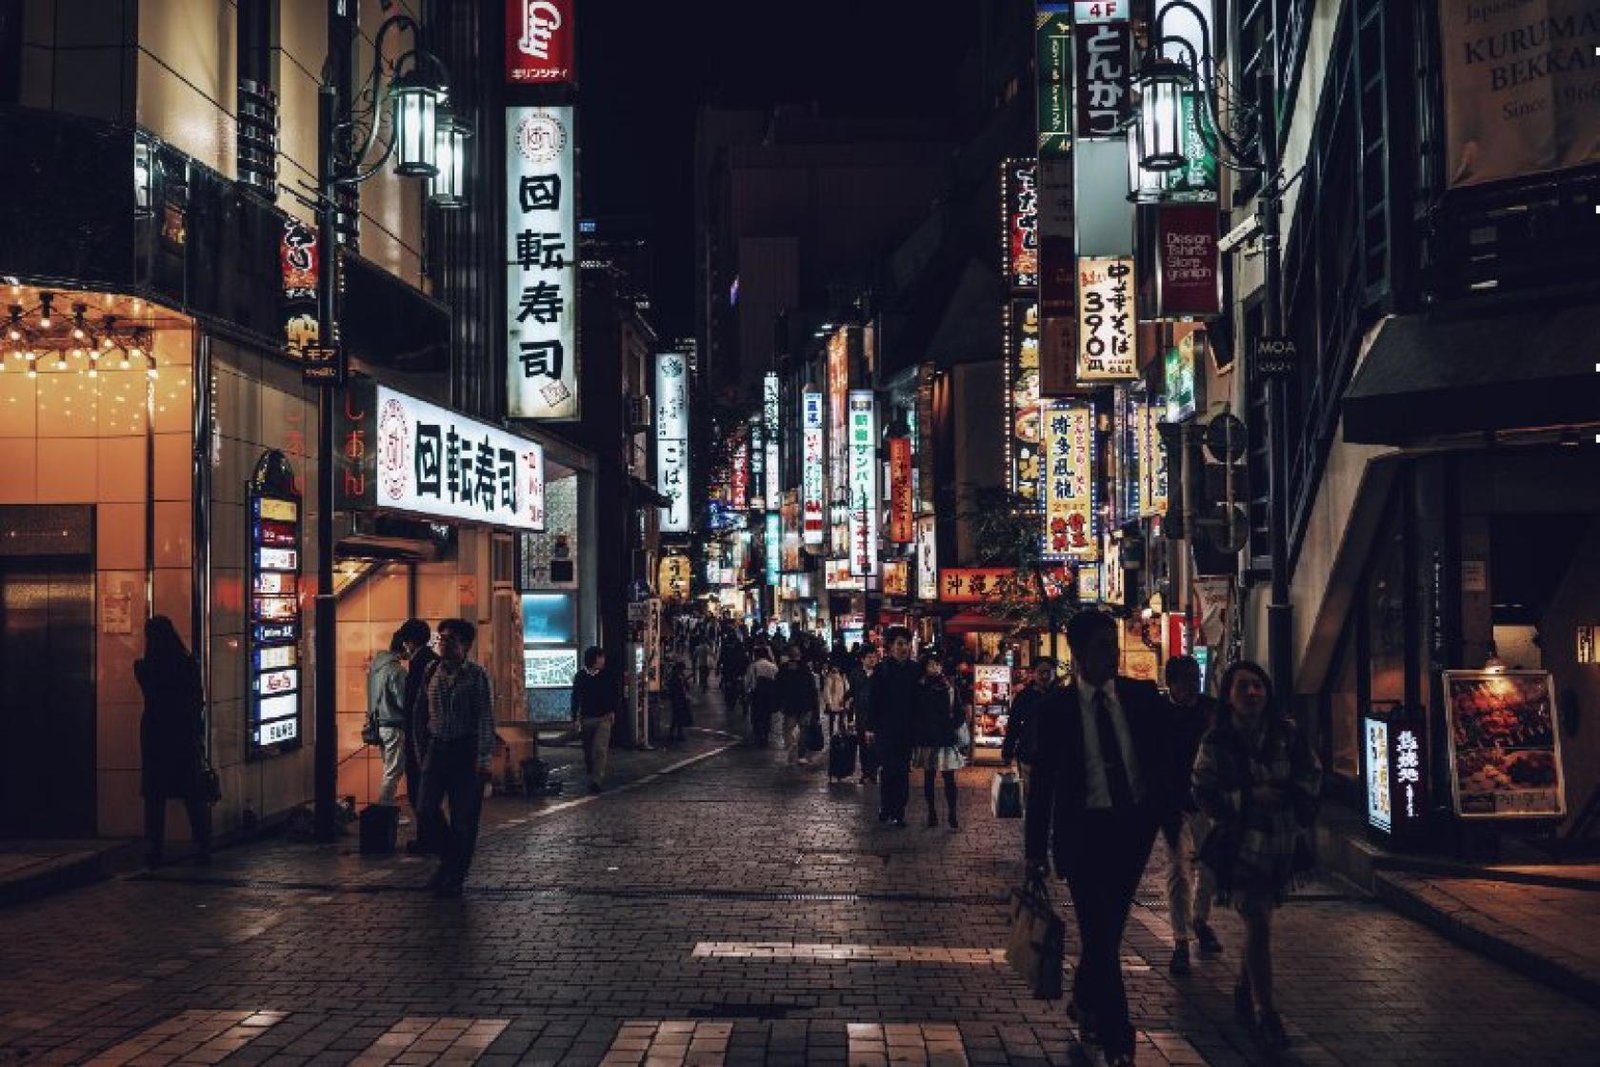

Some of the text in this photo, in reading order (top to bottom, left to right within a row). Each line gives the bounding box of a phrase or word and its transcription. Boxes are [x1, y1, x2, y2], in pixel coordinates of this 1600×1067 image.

[1089, 2, 1117, 18] 4F
[1464, 8, 1600, 65] KURUMA
[512, 68, 567, 79] キリンシティ
[1086, 25, 1125, 134] とんかつ
[1167, 232, 1212, 247] Design
[1167, 256, 1200, 268] Store
[516, 173, 565, 381] 回転寿司
[1107, 264, 1132, 357] 中華そば
[307, 349, 337, 360] モア
[1258, 341, 1296, 355] MOA
[415, 421, 516, 514] 回転寿司
